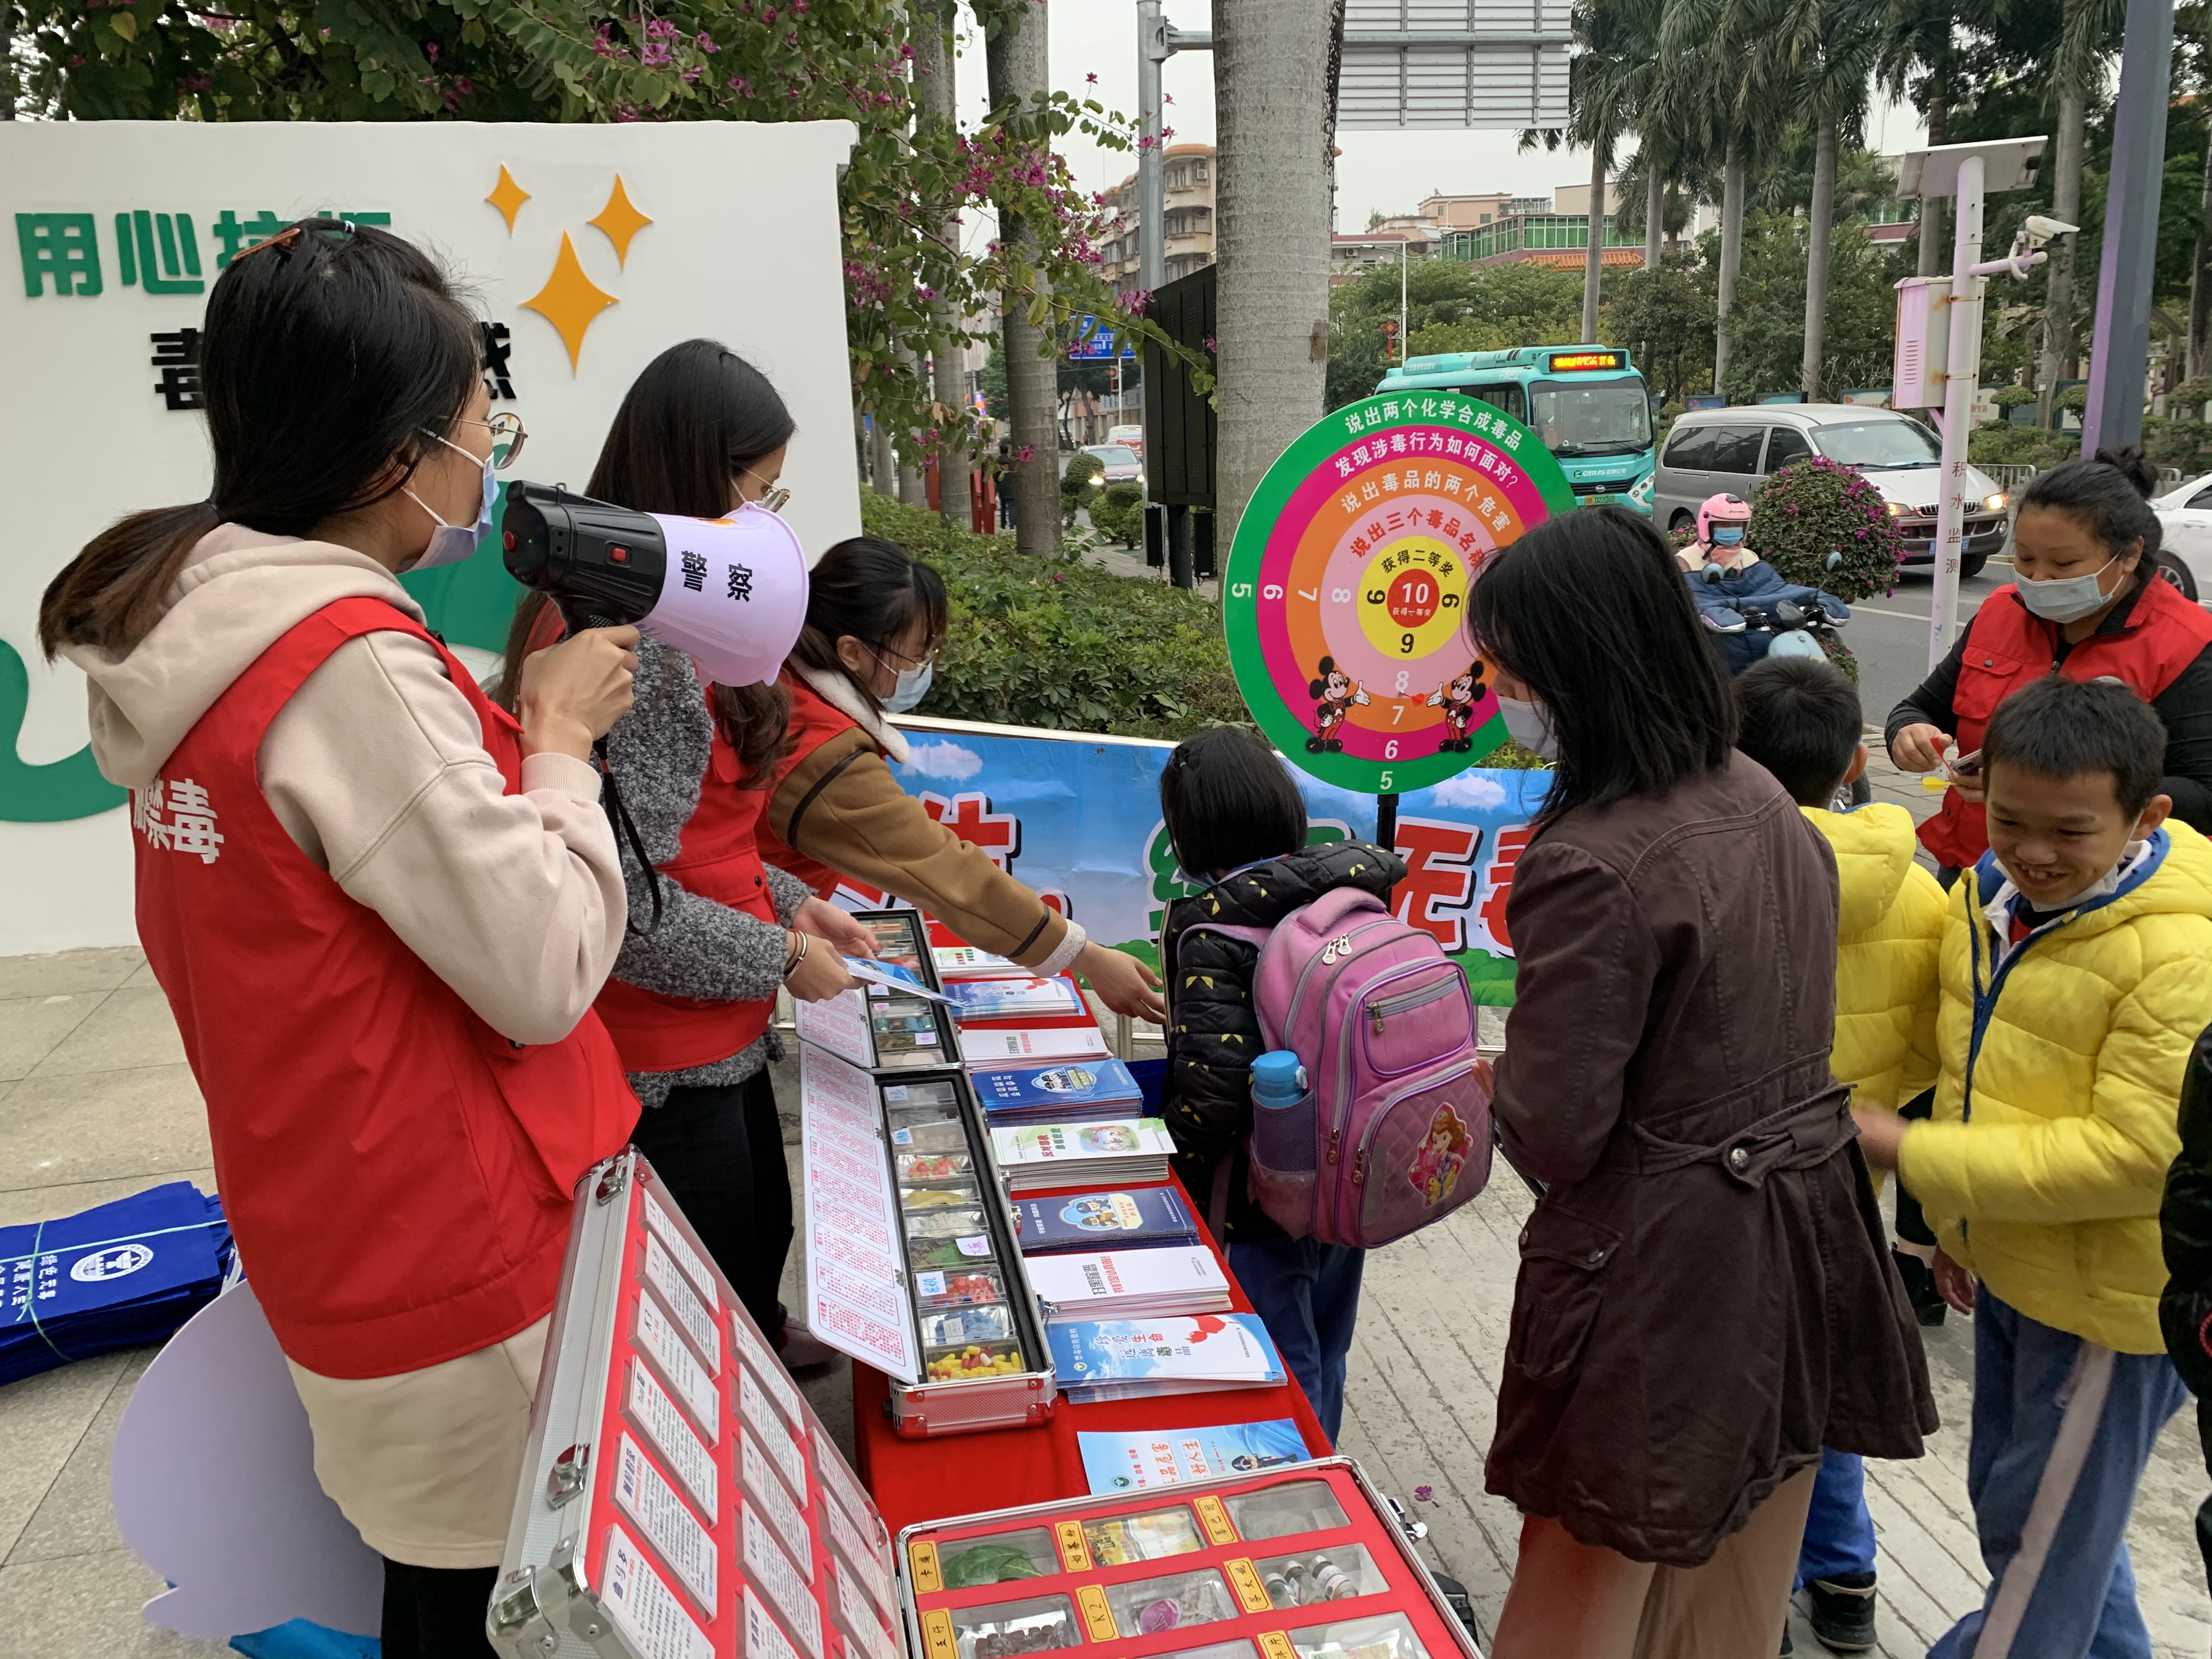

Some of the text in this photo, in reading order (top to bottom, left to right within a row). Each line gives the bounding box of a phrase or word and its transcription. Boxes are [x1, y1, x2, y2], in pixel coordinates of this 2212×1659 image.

[1345, 398, 1522, 451] 说出两个化学合成毒品
[1335, 431, 1518, 488] 发现涉毒行为如何面对?
[1341, 470, 1511, 532] 说出毒品的两个危害
[1946, 460, 1966, 574] 积水监测
[1381, 549, 1454, 578] 获得二等奖
[681, 549, 754, 603] 警察
[1232, 584, 1252, 598] 5
[1298, 587, 1318, 602] 7
[1331, 588, 1351, 603] 8
[1402, 583, 1429, 605] 10
[1392, 607, 1431, 617] 获得一等奖
[1400, 633, 1415, 654] 9
[1395, 670, 1410, 691] 8
[1392, 706, 1405, 726] 7
[1385, 740, 1398, 760] 6
[1380, 770, 1393, 791] 5
[1002, 1074, 1022, 1098] 全民参与
[1037, 1134, 1054, 1158] 反对邪教
[1082, 1263, 1107, 1296] 扫黑除恶
[1099, 1255, 1125, 1294] 我们是认真的!
[1094, 1332, 1164, 1346] 珍爱生命
[1121, 1345, 1192, 1360] 远离毒品
[1182, 1440, 1207, 1478] 好人生
[623, 1446, 635, 1499] 阿拉伯茶
[612, 1545, 628, 1601] 曲马多
